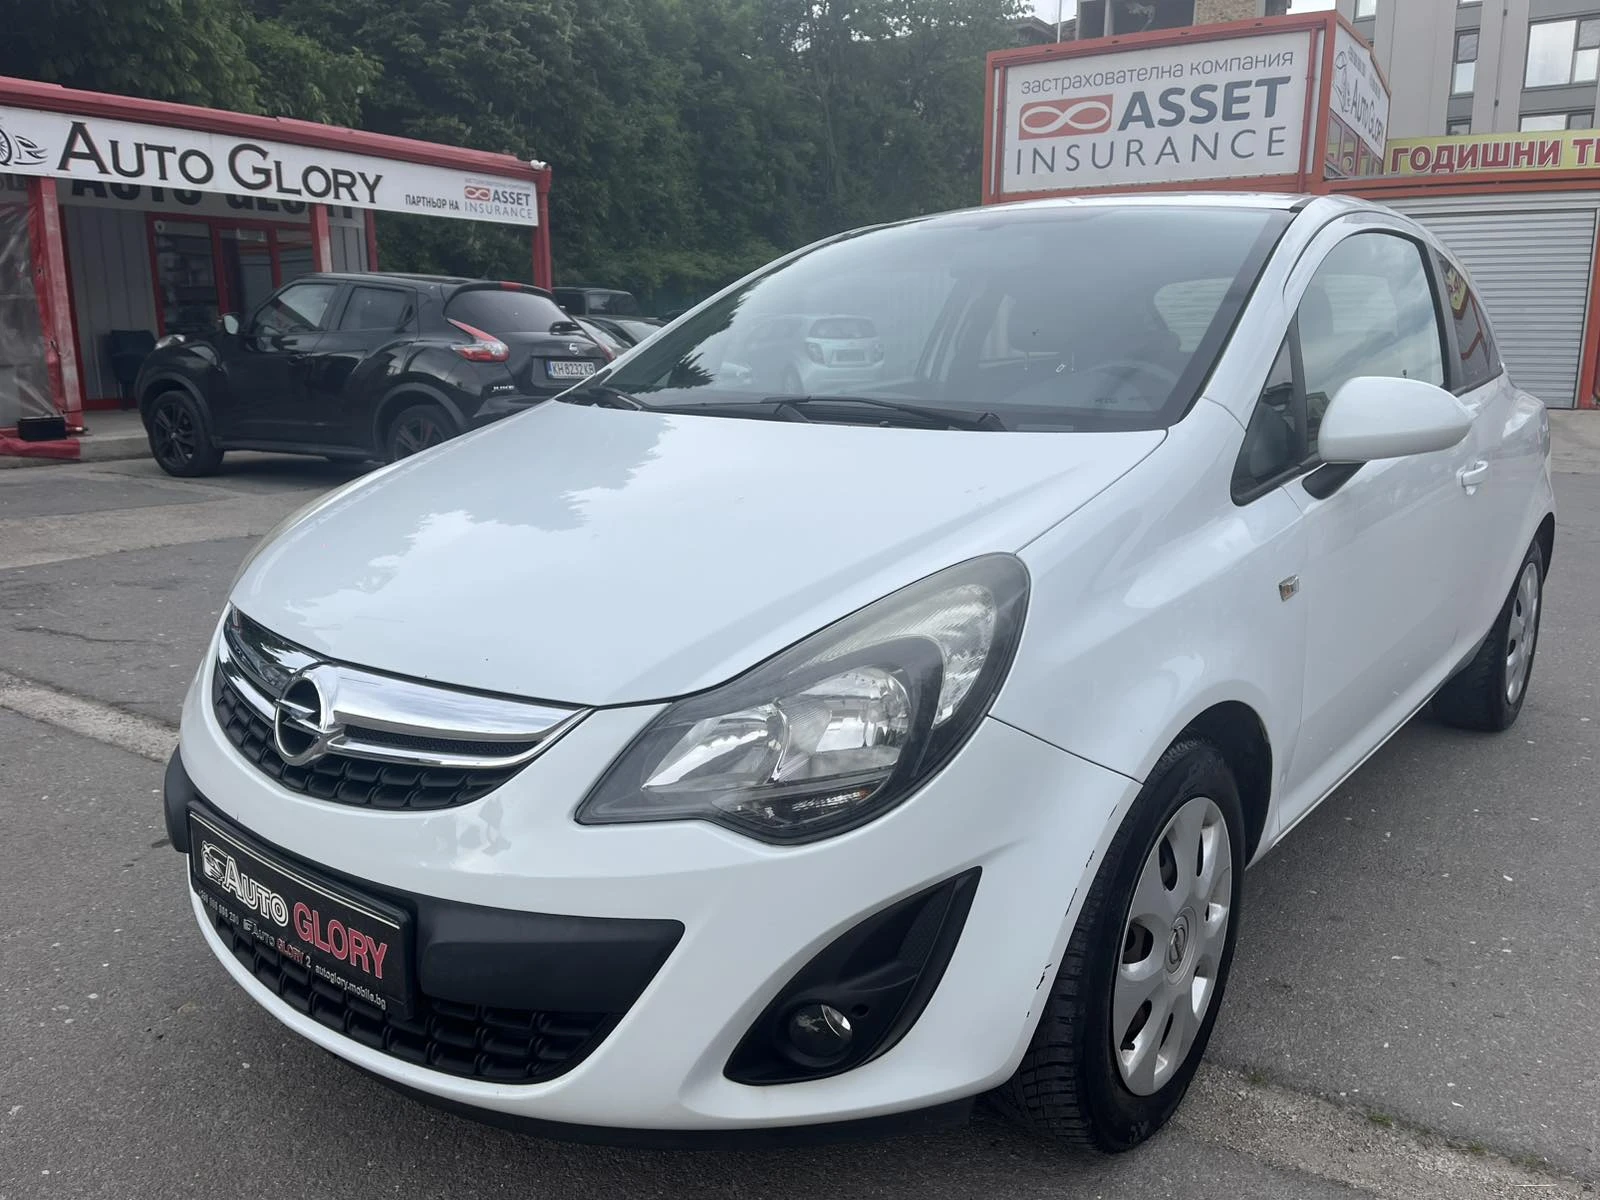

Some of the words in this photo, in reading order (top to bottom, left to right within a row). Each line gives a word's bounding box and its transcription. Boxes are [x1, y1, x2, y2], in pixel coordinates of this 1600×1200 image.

[1021, 63, 1184, 94] застрахователна
[1190, 51, 1294, 78] компания
[1117, 75, 1292, 132] ASSET
[57, 121, 214, 185] AUTO
[228, 143, 383, 204] GLORY
[1016, 126, 1287, 176] INSURANCE
[1390, 139, 1562, 174] ГОДИШНИ
[1572, 137, 1600, 165] Т
[449, 199, 460, 211] НА
[464, 201, 533, 219] INSURANCE
[492, 189, 531, 206] ASSET
[222, 855, 288, 927] AUTO
[293, 901, 388, 980] GLORY
[315, 964, 387, 1011] autoglory.mobile.bg
